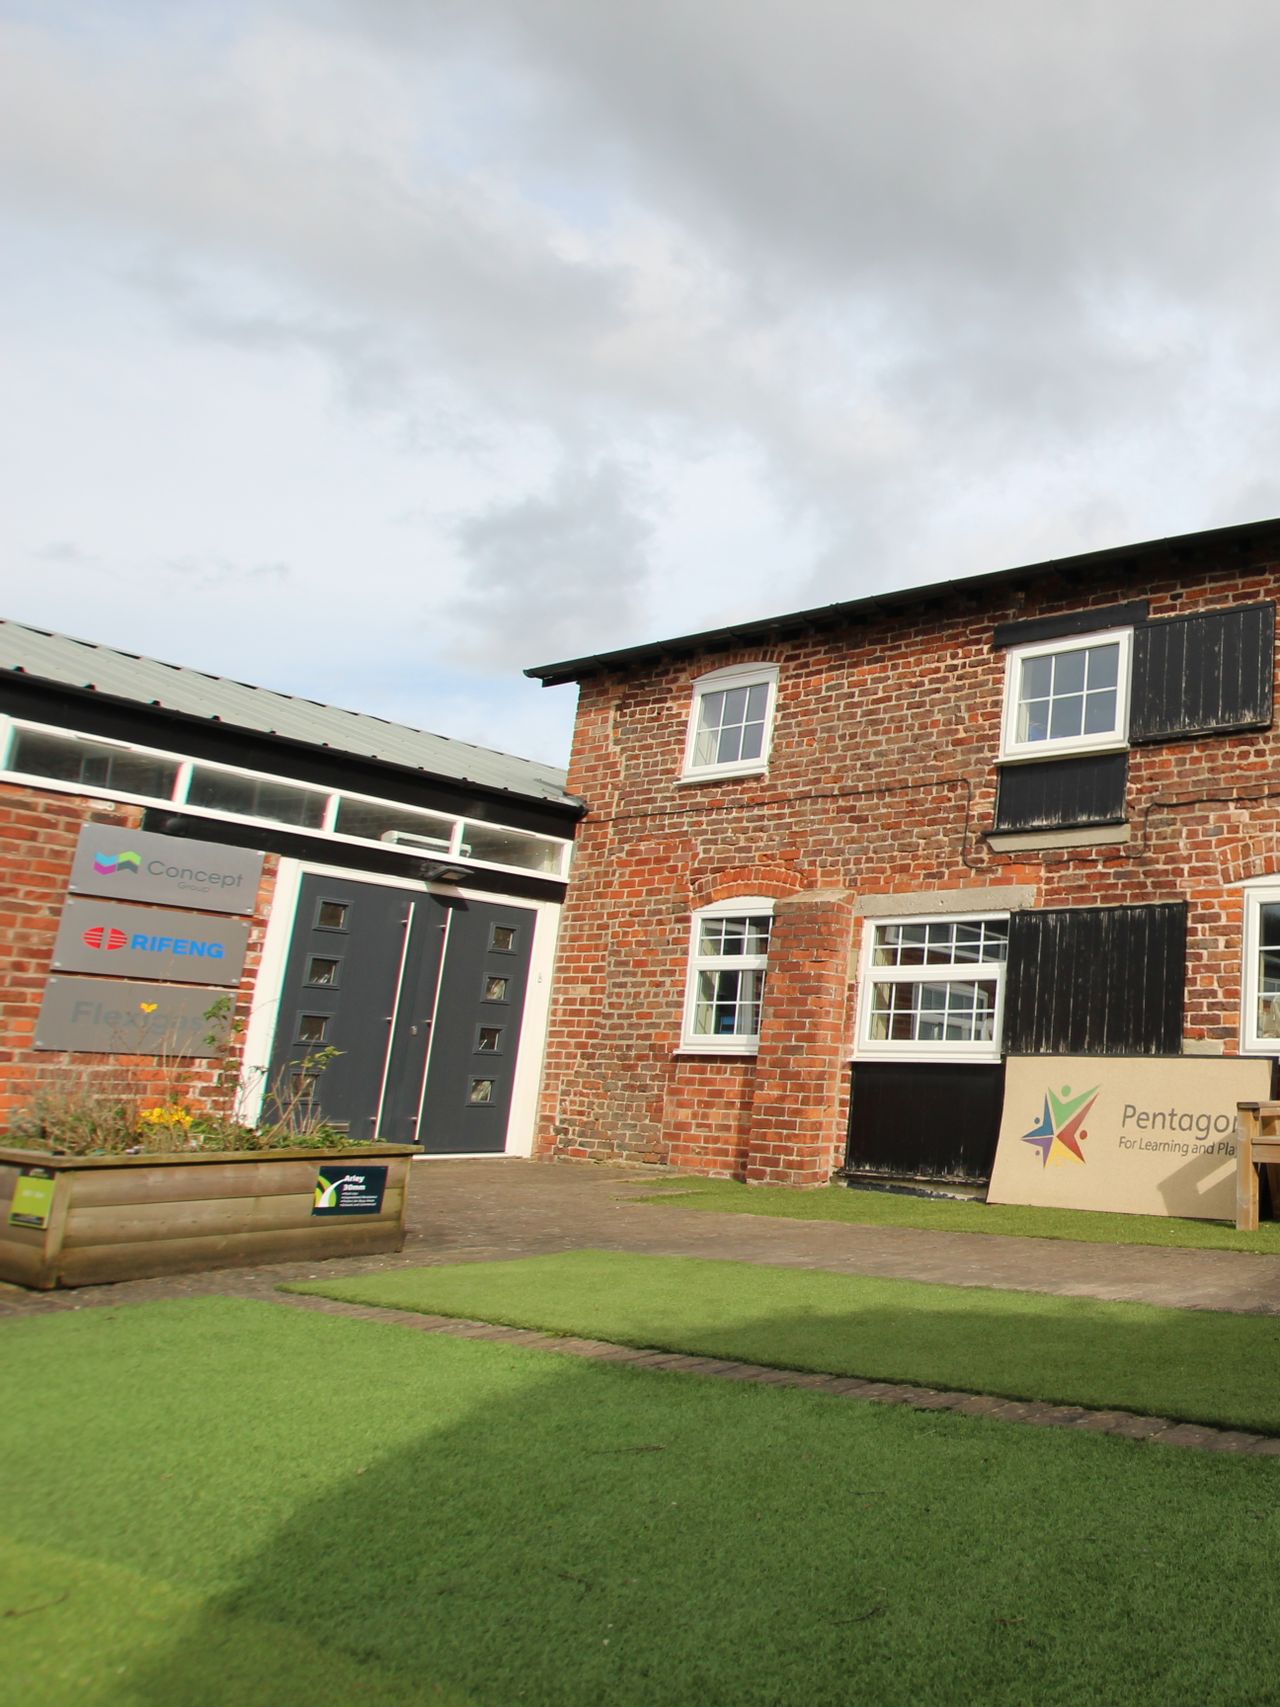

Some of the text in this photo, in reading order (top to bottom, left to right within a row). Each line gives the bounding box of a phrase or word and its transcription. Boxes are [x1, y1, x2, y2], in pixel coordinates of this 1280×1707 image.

[147, 860, 244, 888] Concept
[177, 881, 209, 893] Group
[131, 933, 225, 959] RIFENG
[1118, 1136, 1237, 1158] For Learning and Pla
